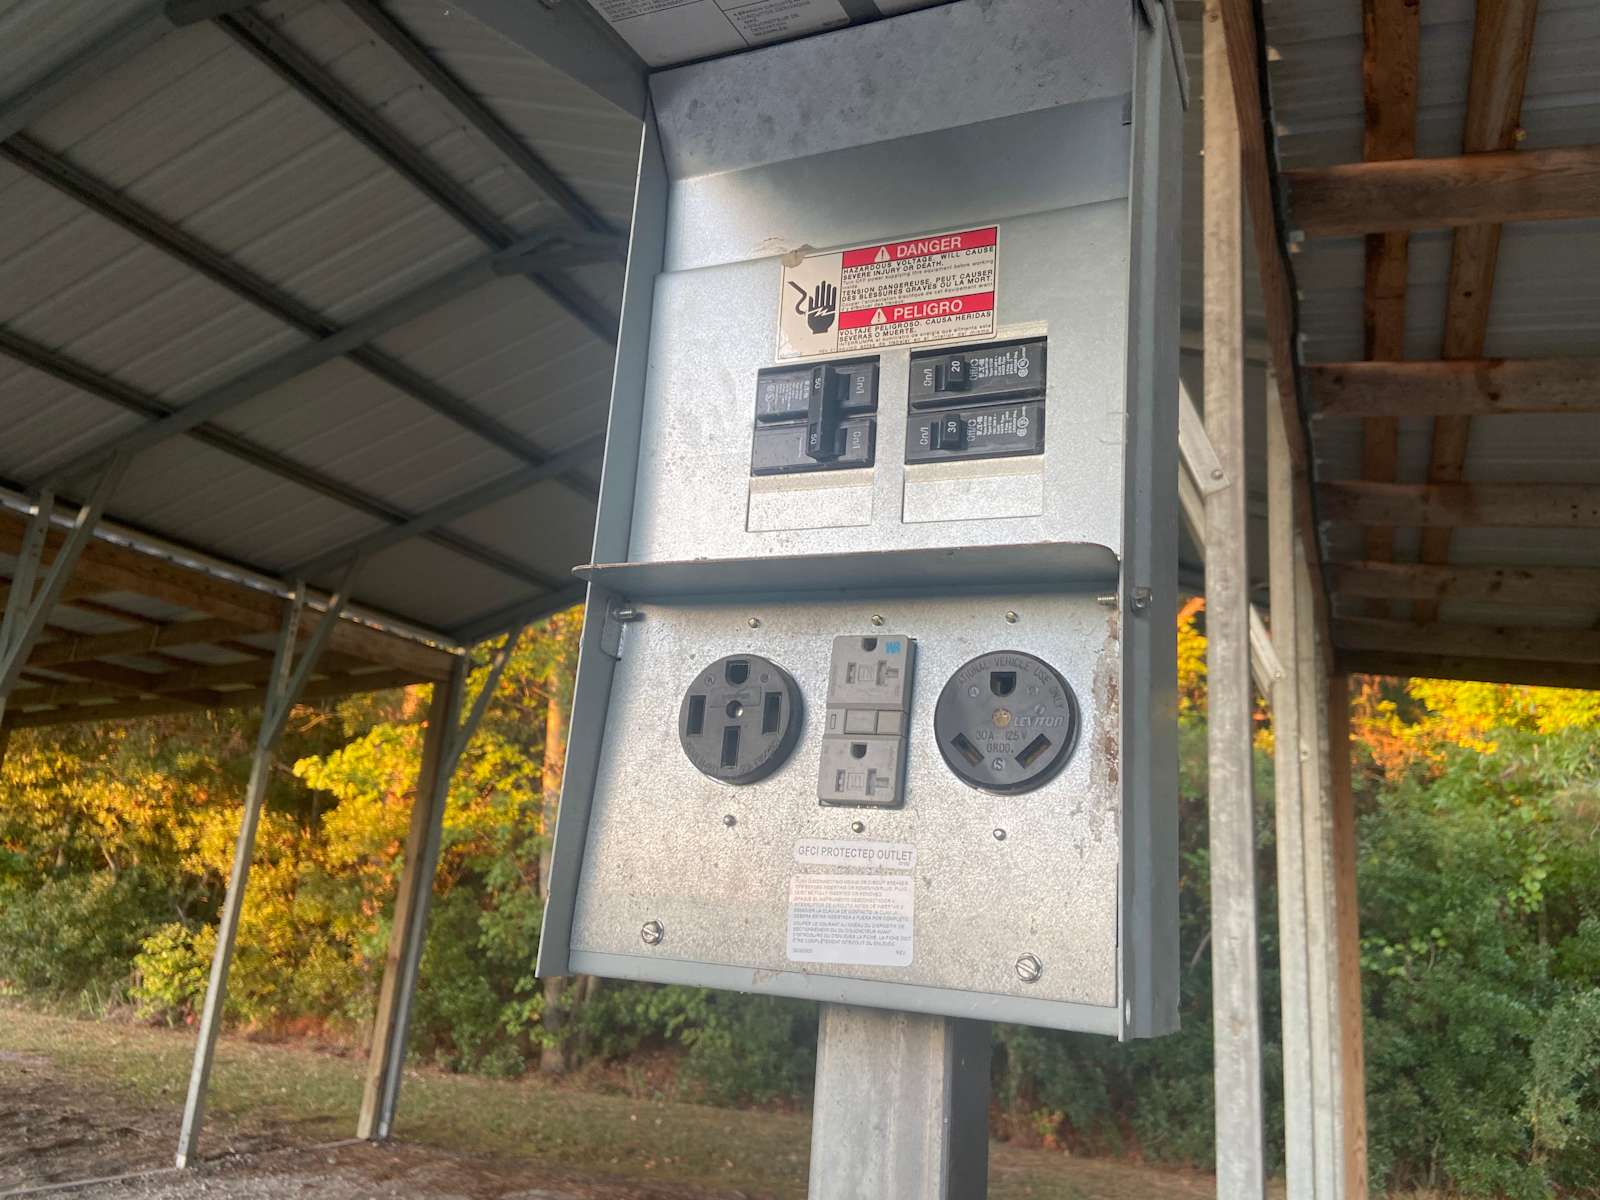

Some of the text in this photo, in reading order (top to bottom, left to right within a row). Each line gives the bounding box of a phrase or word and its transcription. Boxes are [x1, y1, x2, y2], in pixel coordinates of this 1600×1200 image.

[896, 236, 961, 257] DANGER
[843, 262, 891, 274] HAZARDOUS
[940, 251, 960, 259] WILL
[965, 246, 993, 255] CAUSE
[843, 271, 870, 280] SEVERE
[873, 267, 900, 276] INJURY
[916, 260, 943, 269] DEATH.
[842, 287, 874, 296] TENSION
[959, 269, 992, 279] CAUSER
[858, 288, 902, 299] BLESSURES
[905, 283, 936, 292] GRAVES
[967, 275, 992, 283] MORT.
[893, 299, 962, 320] PELIGRO
[839, 326, 872, 336] VOLTAJE
[925, 316, 952, 324] CAUSA
[955, 311, 990, 320] HERIDAS
[839, 333, 872, 342] SEVERAS
[951, 360, 961, 373] 20
[947, 421, 957, 433] 30
[798, 846, 913, 862] GFCI PROTECTED OUTLET
